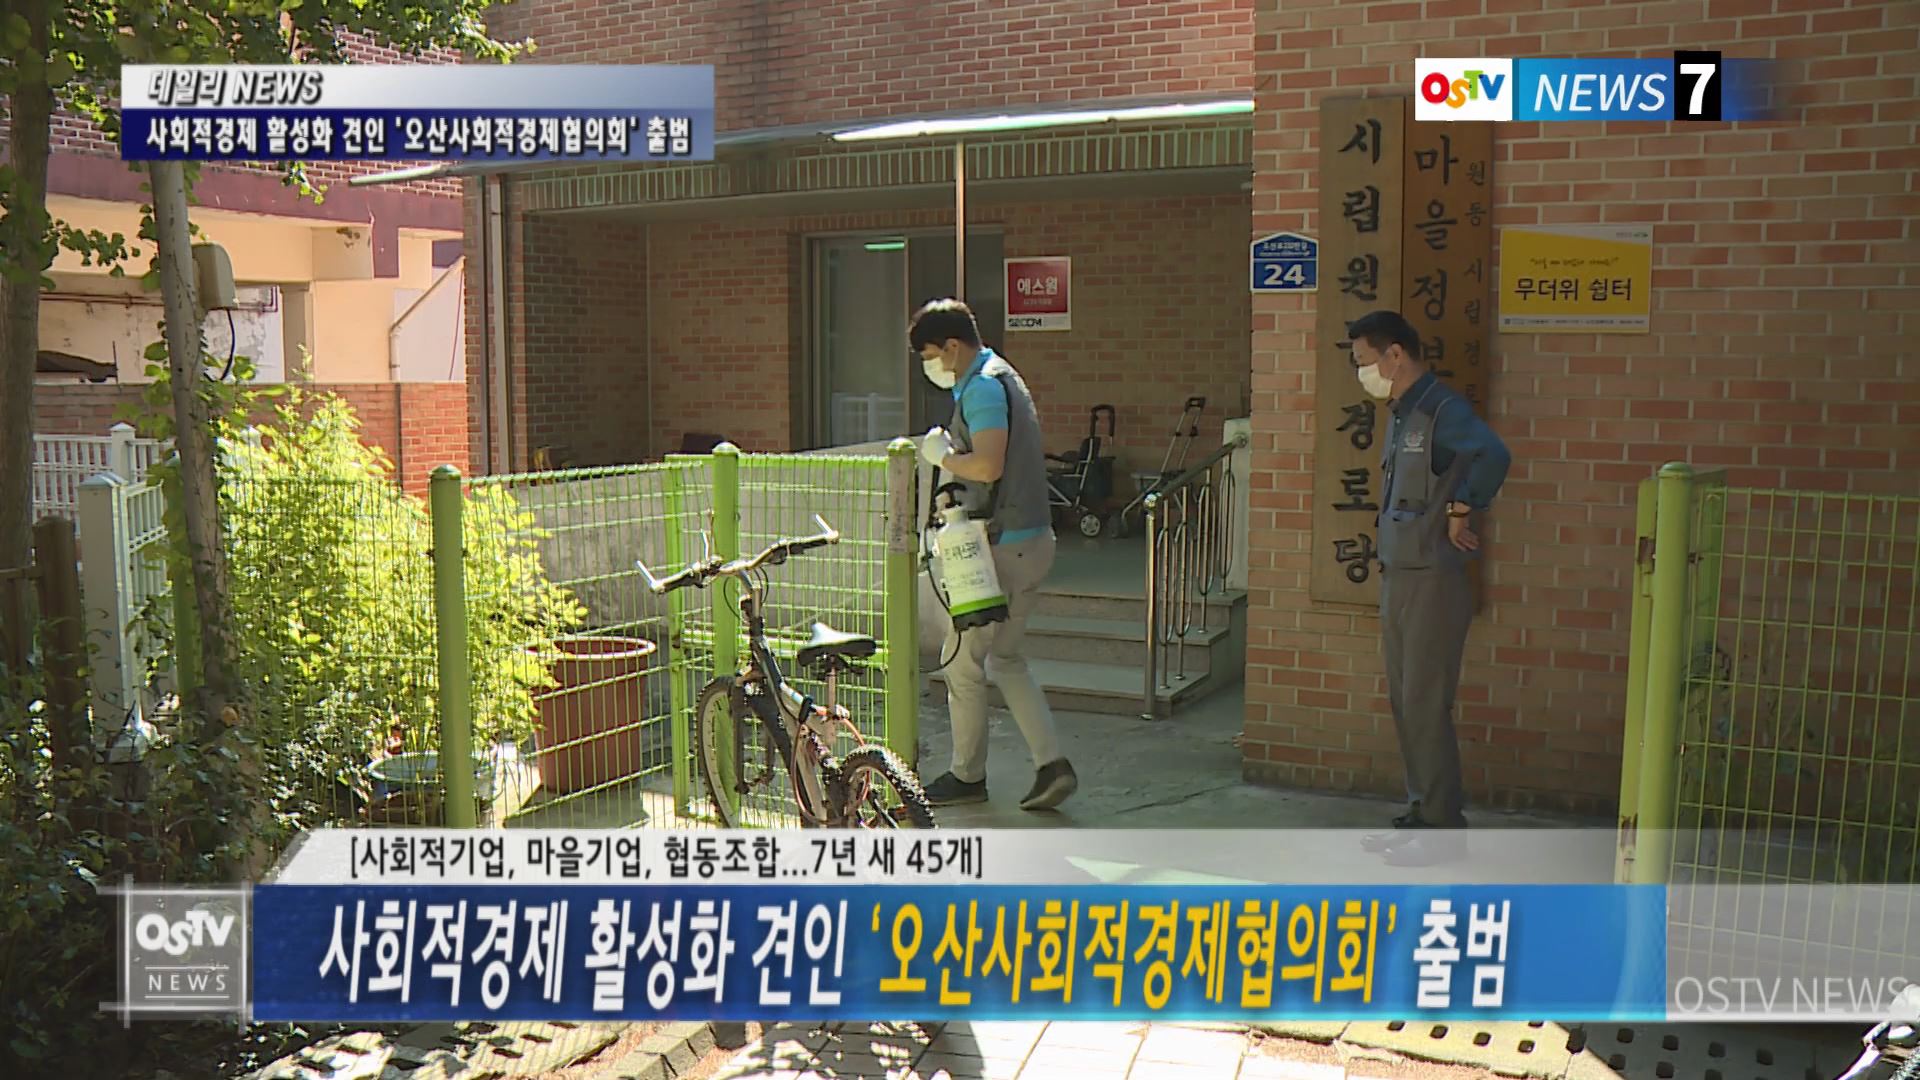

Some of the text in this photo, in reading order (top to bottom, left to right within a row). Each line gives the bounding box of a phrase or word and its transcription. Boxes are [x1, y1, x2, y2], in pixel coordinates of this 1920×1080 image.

[1017, 276, 1058, 295] 에스원
[1264, 264, 1306, 286] 24
[1514, 278, 1579, 301] 무더위
[1331, 118, 1382, 584] 시립원경로당
